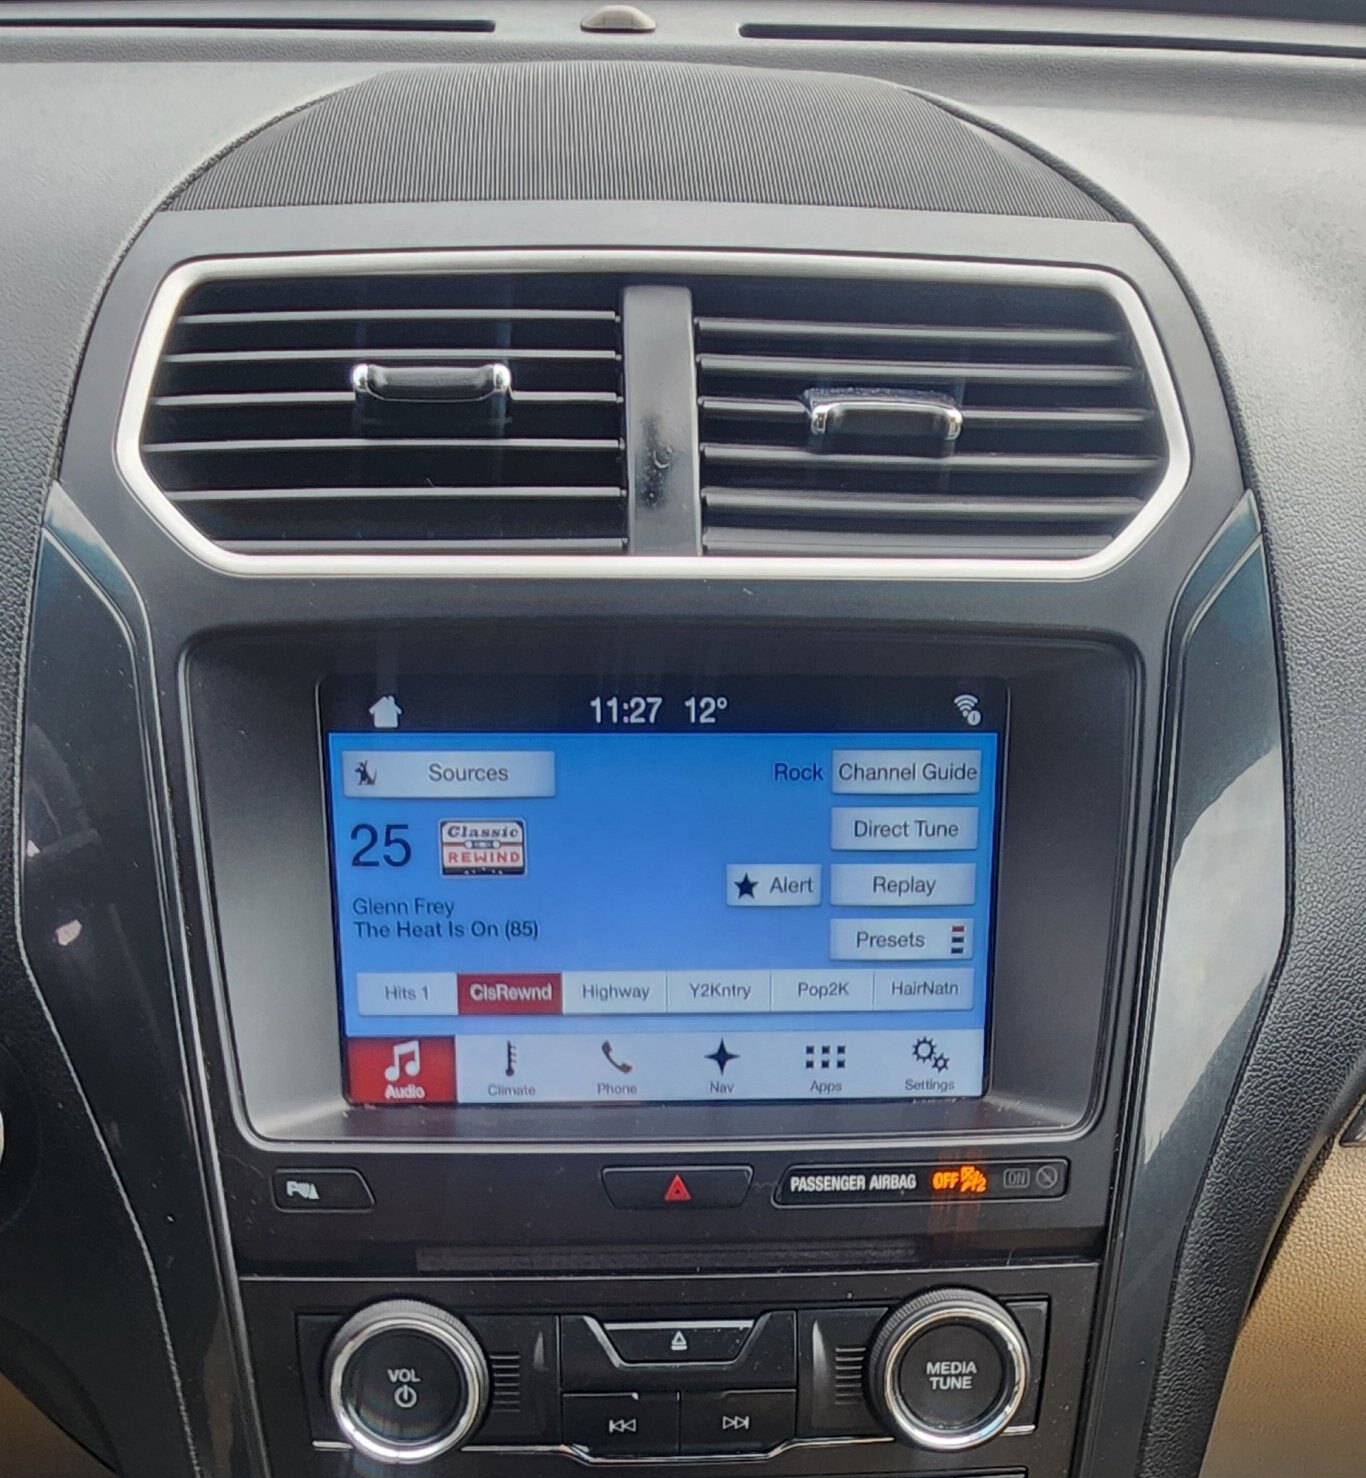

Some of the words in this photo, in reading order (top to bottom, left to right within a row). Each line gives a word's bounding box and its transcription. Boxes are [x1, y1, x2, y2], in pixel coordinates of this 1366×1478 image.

[590, 696, 663, 724] 11:27
[428, 763, 509, 782] Sources
[773, 763, 824, 781] Rock
[838, 763, 916, 781] Channel
[922, 763, 978, 781] Guide
[447, 826, 519, 839] Classic
[853, 820, 910, 838] Direct
[914, 820, 959, 838] Tune
[350, 823, 412, 867] 25
[447, 851, 520, 864] REWIND
[769, 876, 815, 894] Alert
[872, 876, 937, 898] Replay
[352, 898, 409, 916] Glenn
[414, 898, 455, 918] Frey
[354, 921, 391, 938] The
[396, 921, 443, 938] Heat
[449, 922, 465, 937] Is
[471, 921, 499, 938] On
[504, 920, 539, 941] (85)
[855, 931, 926, 949] Presets
[384, 985, 417, 1000] Hits
[422, 985, 429, 1000] 1
[469, 983, 553, 1001] ClsRewnd
[582, 983, 650, 1002] Highway
[689, 983, 752, 1000] Y2Kntry
[797, 981, 849, 999] Pop2K
[891, 981, 959, 996] HairNatn
[384, 1084, 425, 1099] Audio
[487, 1083, 536, 1097] Climate
[596, 1082, 638, 1096] Phone
[709, 1081, 734, 1094] Nav
[810, 1080, 843, 1094] Apps
[904, 1079, 955, 1094] Settings
[790, 1174, 865, 1193] PASSENGER
[869, 1173, 917, 1191] AIRBAG
[932, 1171, 960, 1190] OFF
[387, 1368, 421, 1383] VOL
[926, 1361, 978, 1375] MEDIA
[929, 1376, 973, 1390] TUNE
